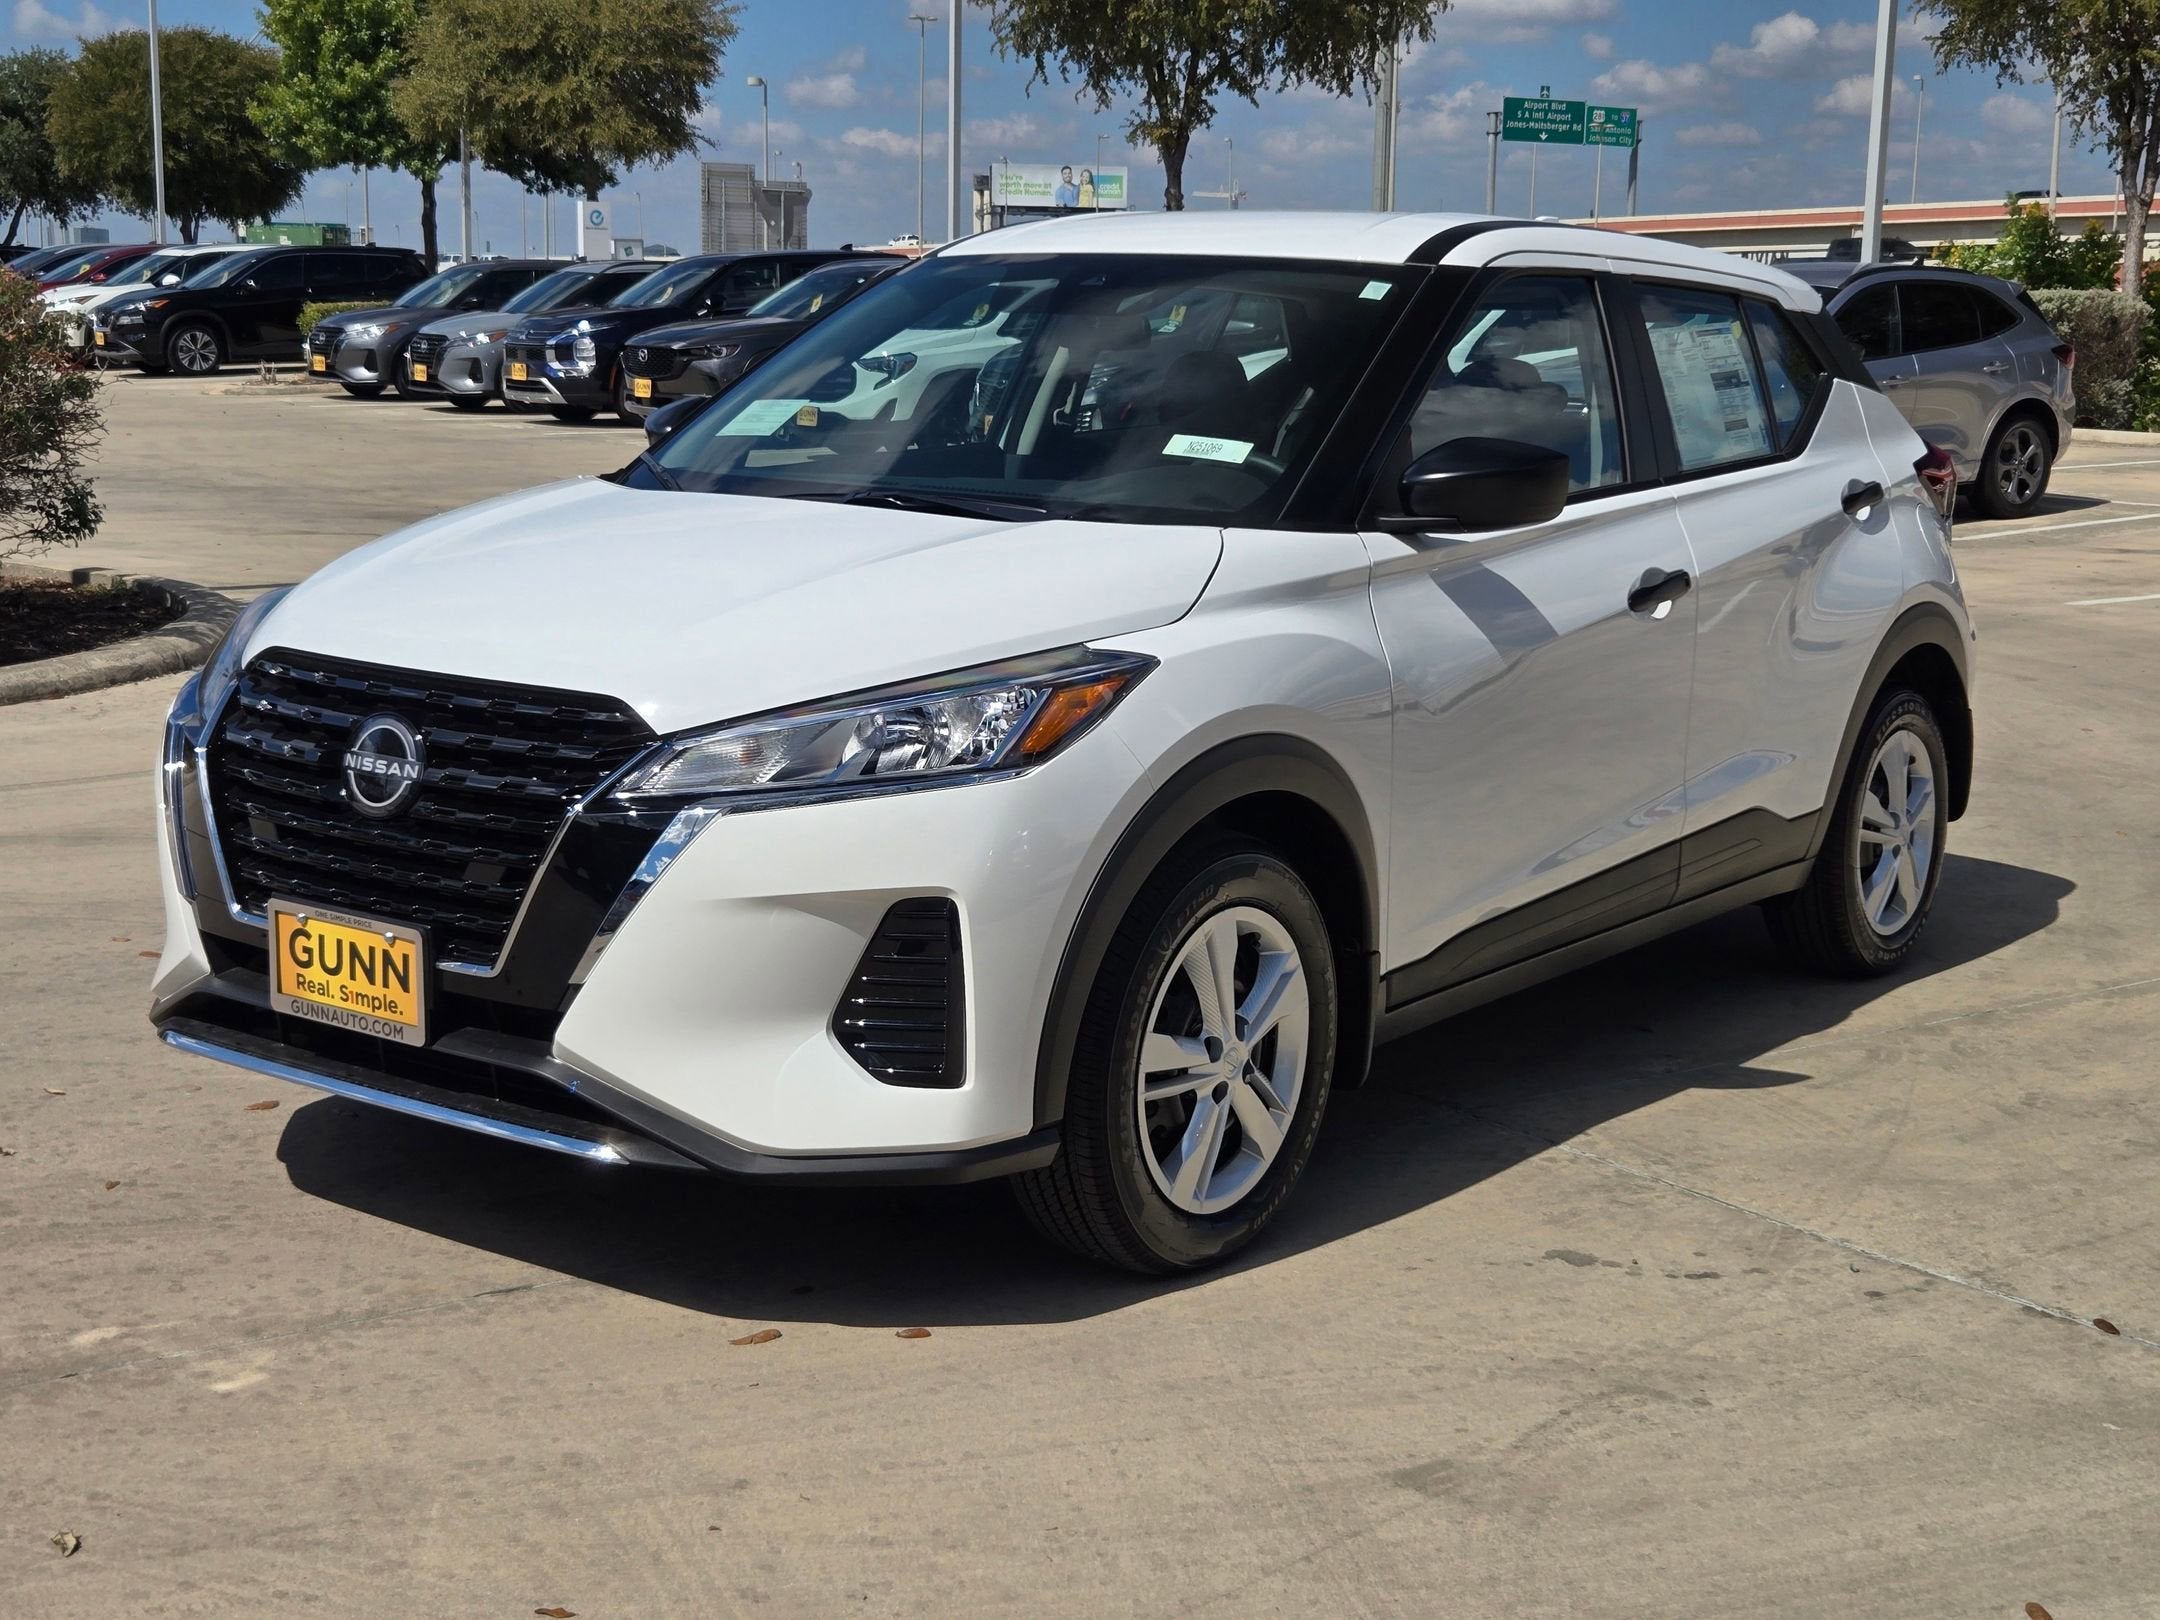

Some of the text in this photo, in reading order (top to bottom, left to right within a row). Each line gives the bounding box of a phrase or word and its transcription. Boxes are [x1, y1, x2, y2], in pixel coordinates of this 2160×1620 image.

[1523, 101, 1567, 110] Airport Blvd
[1532, 111, 1545, 119] Intl
[1547, 112, 1571, 122] Airport
[1572, 123, 1582, 131] Rd
[1618, 136, 1633, 145] City
[345, 753, 419, 779] NISSAN
[314, 910, 372, 929] ONE SIMPLE PRICE
[289, 927, 410, 994] GUNN
[296, 972, 335, 999] Real.
[291, 999, 404, 1040] GUNNAUTO.COM
